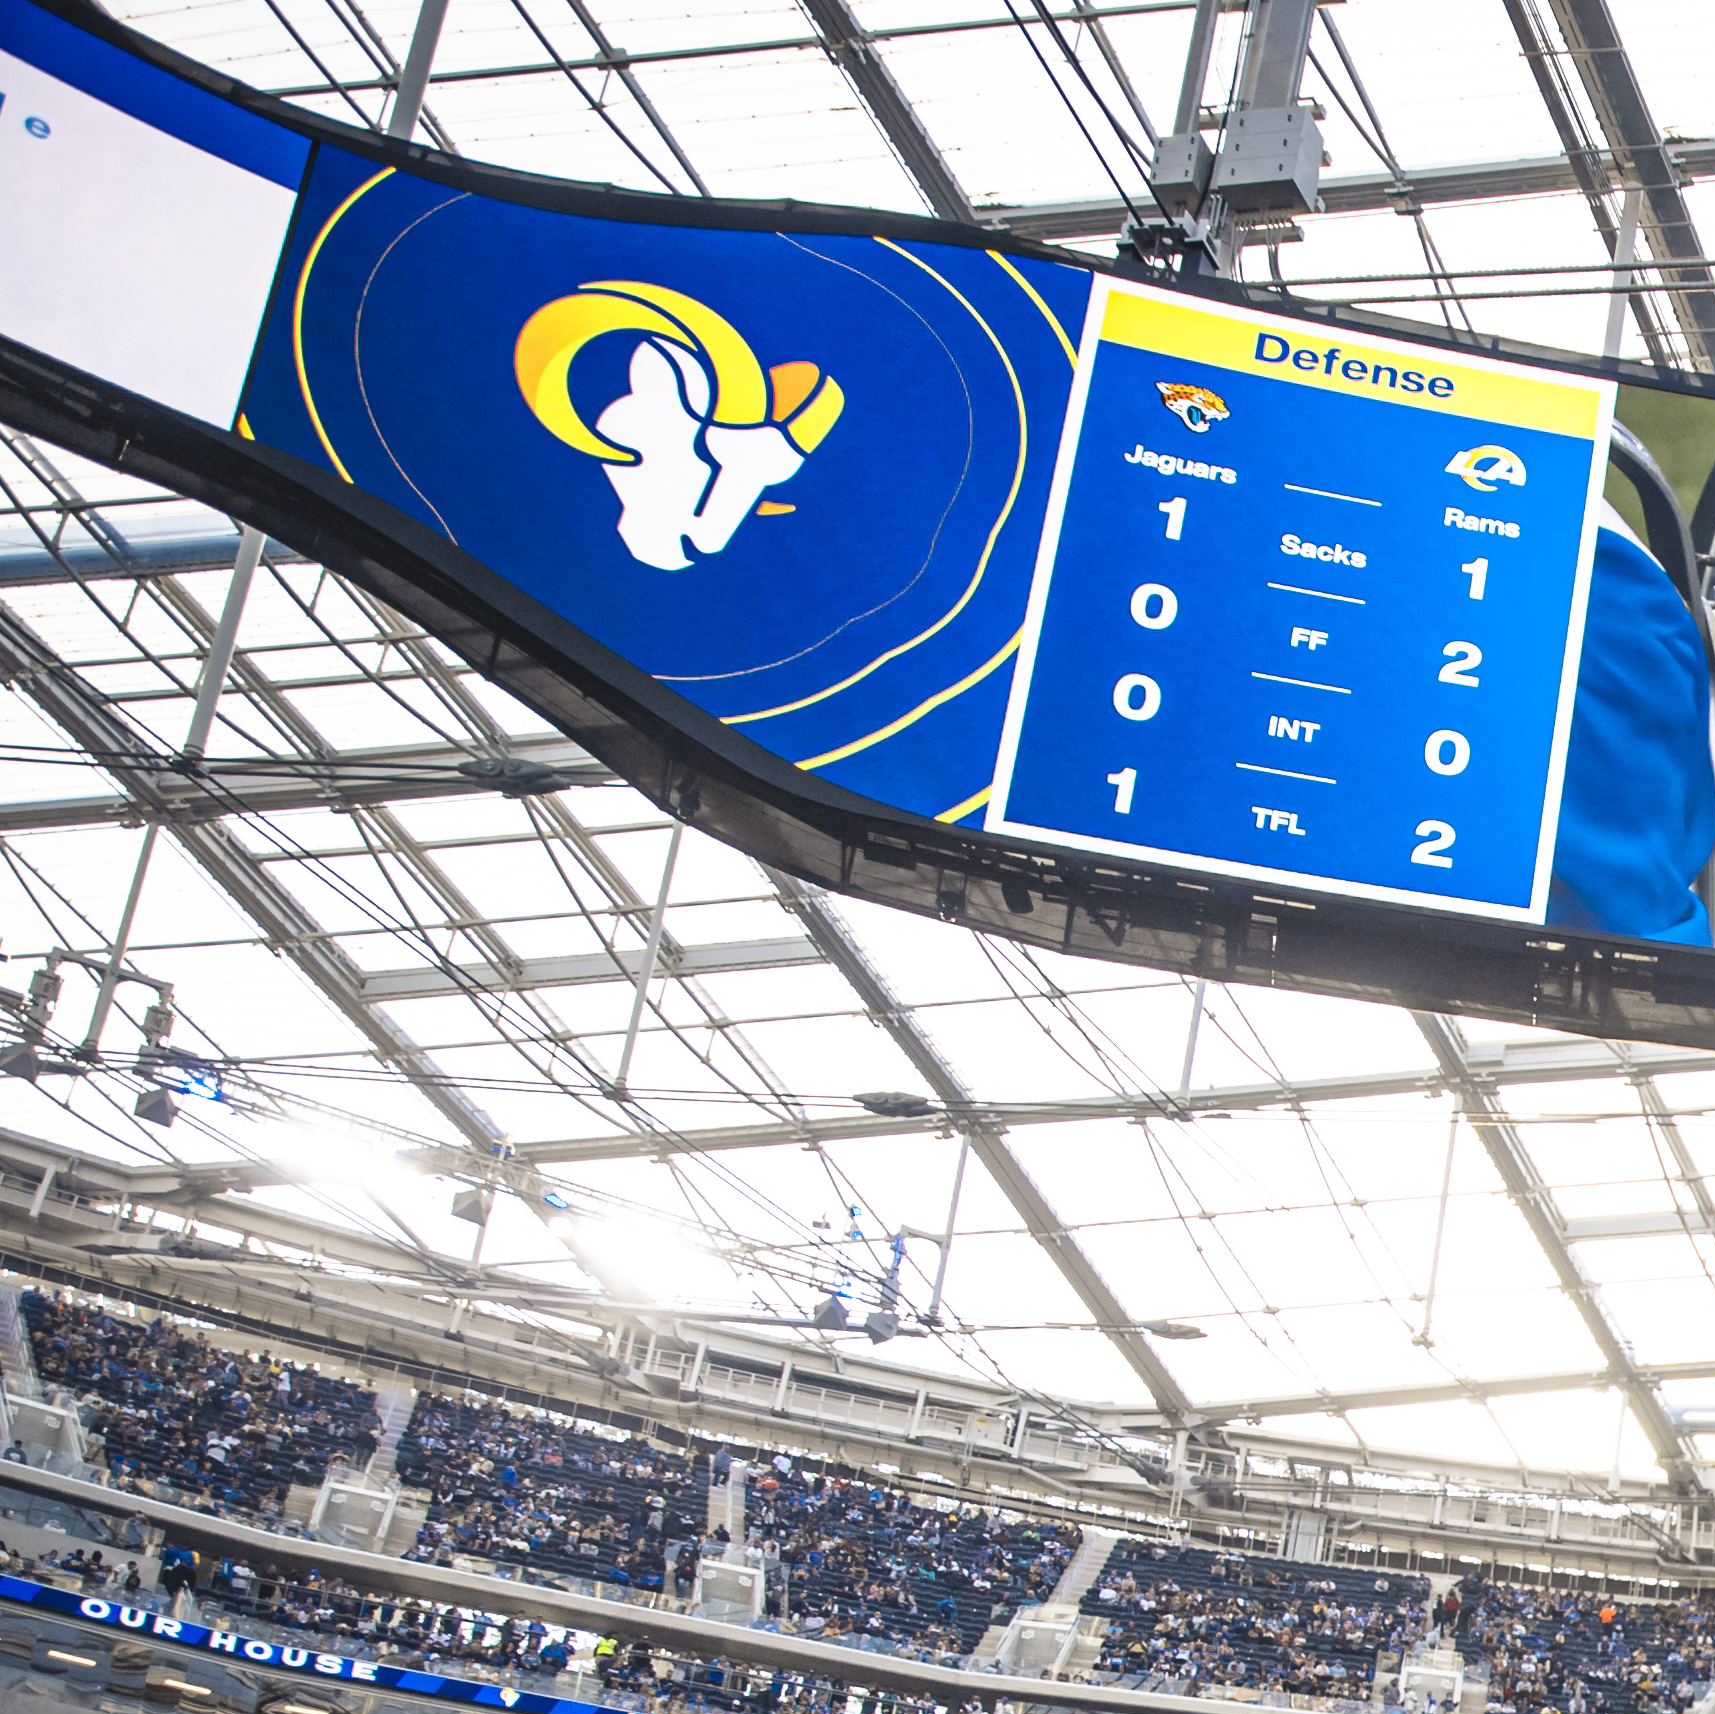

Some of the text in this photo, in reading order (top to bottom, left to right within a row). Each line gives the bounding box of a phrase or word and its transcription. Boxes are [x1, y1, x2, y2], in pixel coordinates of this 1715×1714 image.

[1254, 331, 1455, 398] Defense
[1124, 443, 1238, 485] Jaguars
[1158, 496, 1489, 601] 1 Sacks 1
[1443, 506, 1521, 539] Rams
[1129, 582, 1483, 688] 0 FF 2
[1112, 673, 1470, 777] 0 INT 0
[1107, 767, 1458, 869] 1 TFL 2
[81, 1599, 379, 1681] OUR HOUSE
